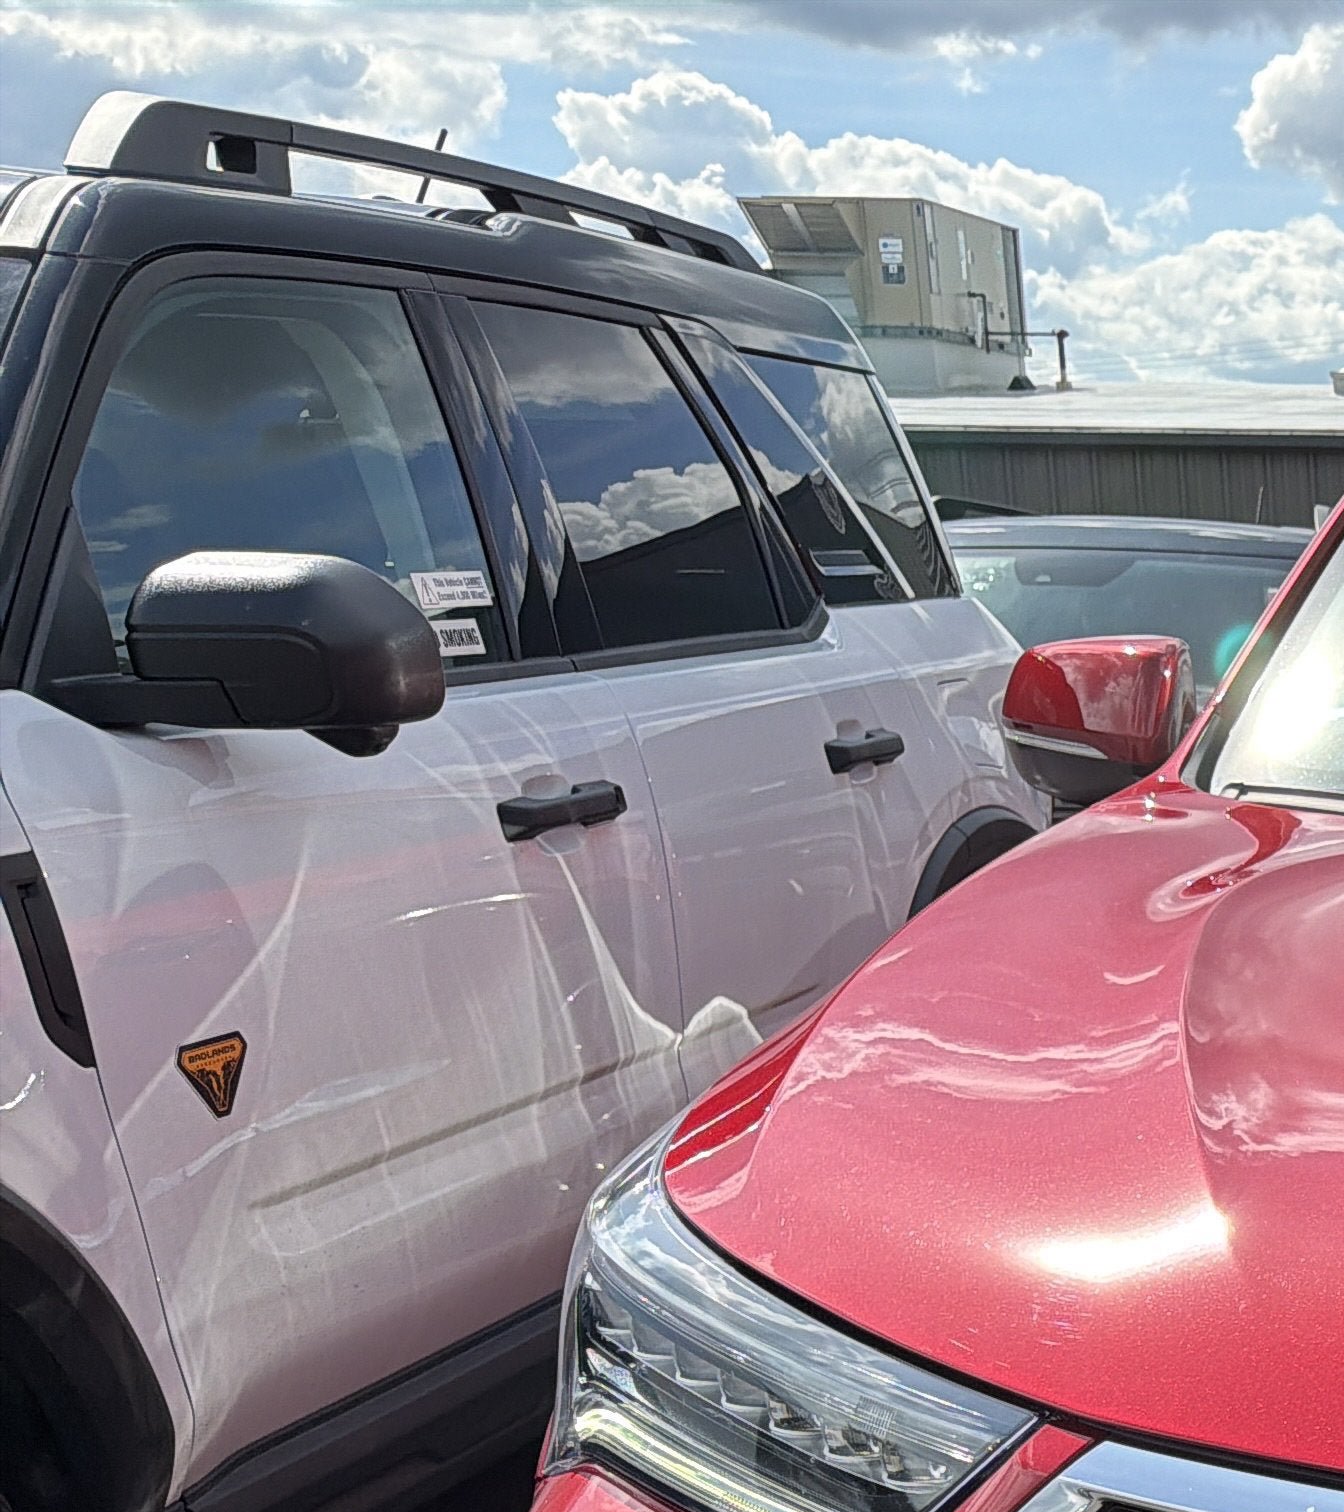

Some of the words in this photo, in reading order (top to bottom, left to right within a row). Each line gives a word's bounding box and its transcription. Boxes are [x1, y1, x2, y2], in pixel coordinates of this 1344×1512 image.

[437, 591, 456, 601] Exceed
[440, 627, 480, 648] SMOKING
[188, 1044, 236, 1064] BADLANDS
